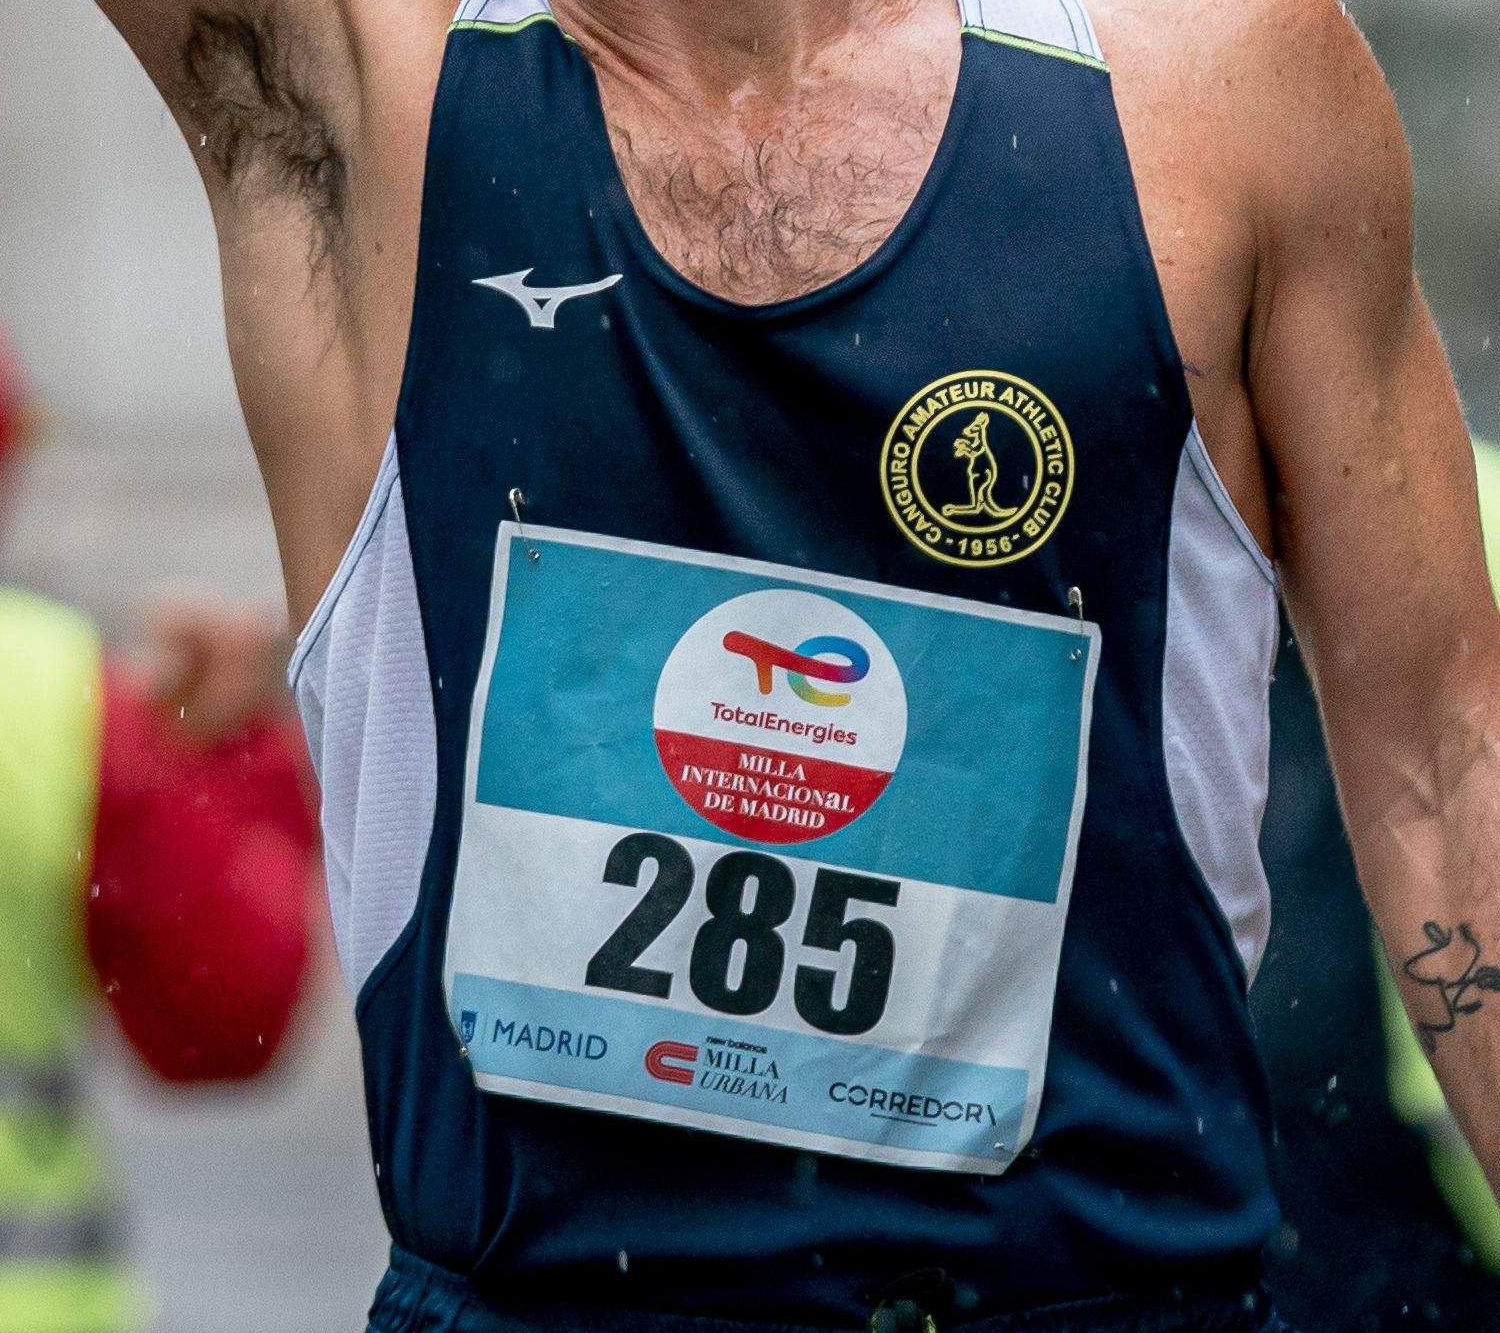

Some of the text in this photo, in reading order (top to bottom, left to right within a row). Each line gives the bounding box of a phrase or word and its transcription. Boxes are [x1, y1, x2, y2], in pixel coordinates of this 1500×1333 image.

[890, 381, 1064, 544] CANGURO AMATEUR ATHLETIC CLUB
[711, 702, 857, 745] TotalEnergies
[739, 753, 806, 780] MILLA
[704, 792, 826, 829] DE MADRID
[584, 831, 901, 1036] 285
[492, 1019, 608, 1060] MADRID
[705, 1048, 779, 1079] MILLA
[700, 1071, 788, 1104] URBANA
